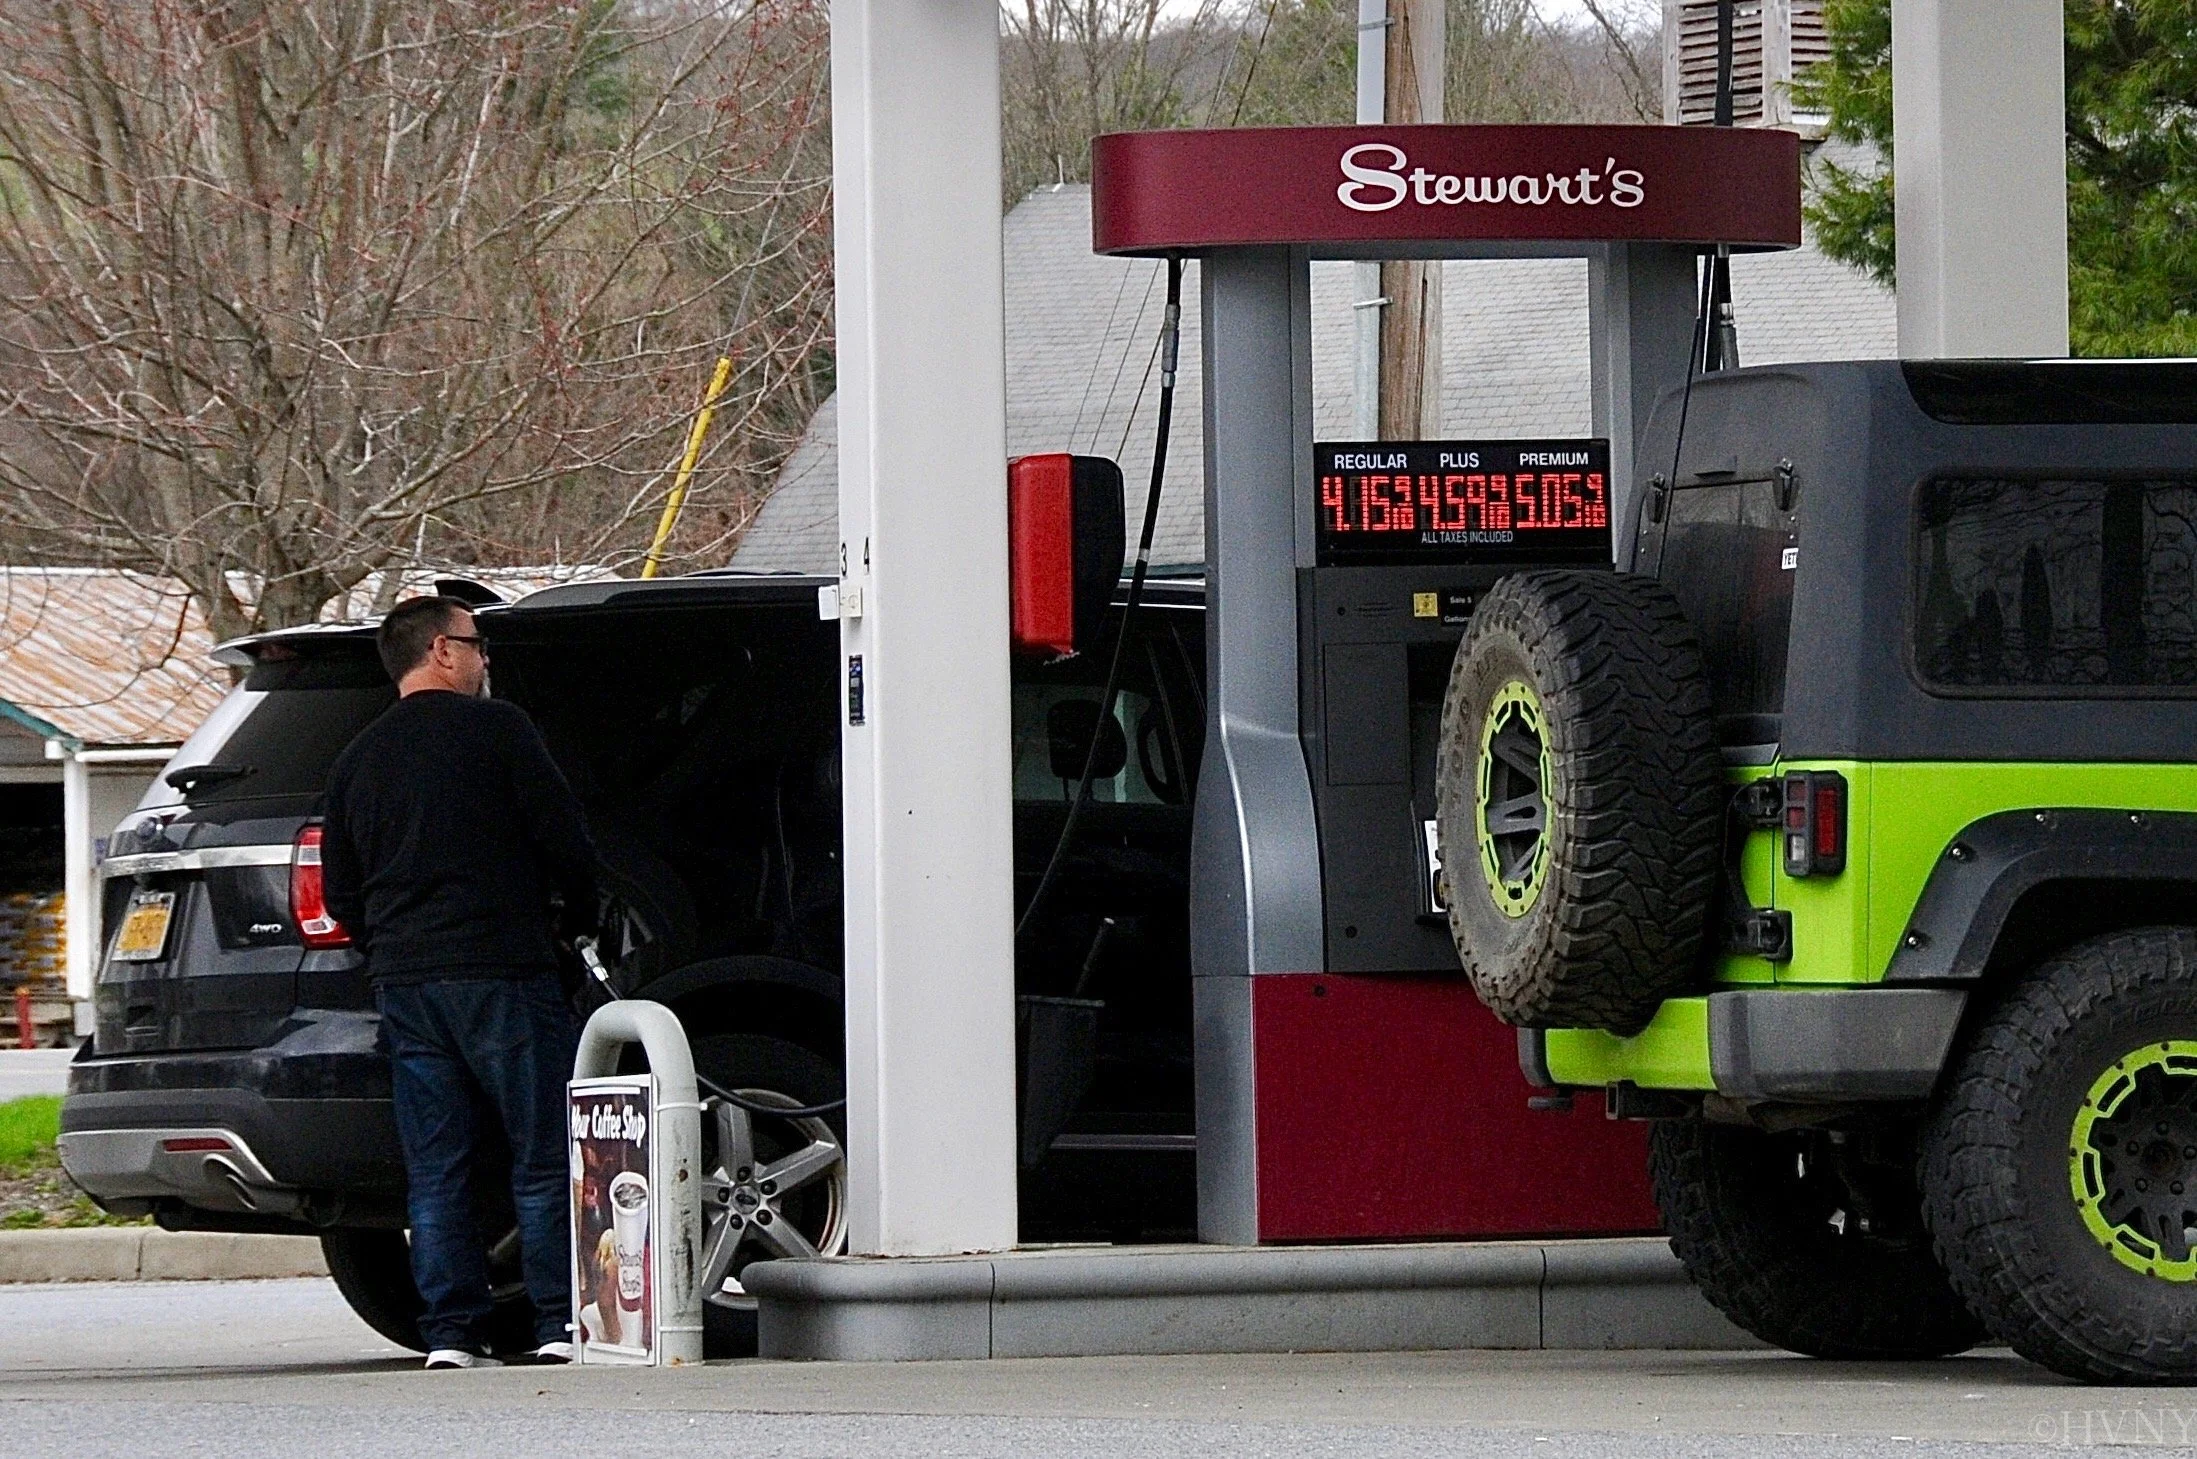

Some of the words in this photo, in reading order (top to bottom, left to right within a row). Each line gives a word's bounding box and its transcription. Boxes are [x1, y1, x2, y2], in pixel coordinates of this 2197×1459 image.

[1337, 143, 1644, 212] Stewart's
[1334, 454, 1408, 469] REGULAR
[1440, 452, 1479, 468] PLUS
[1519, 452, 1589, 466] PREMIUM
[863, 536, 870, 574] 4
[1421, 531, 1438, 544] ALL
[1439, 531, 1467, 544] TAXES
[1469, 530, 1514, 543] INCLUDED
[840, 542, 848, 577] 3
[571, 1104, 591, 1139] Your
[592, 1104, 621, 1140] Coffee
[622, 1104, 646, 1149] Shop
